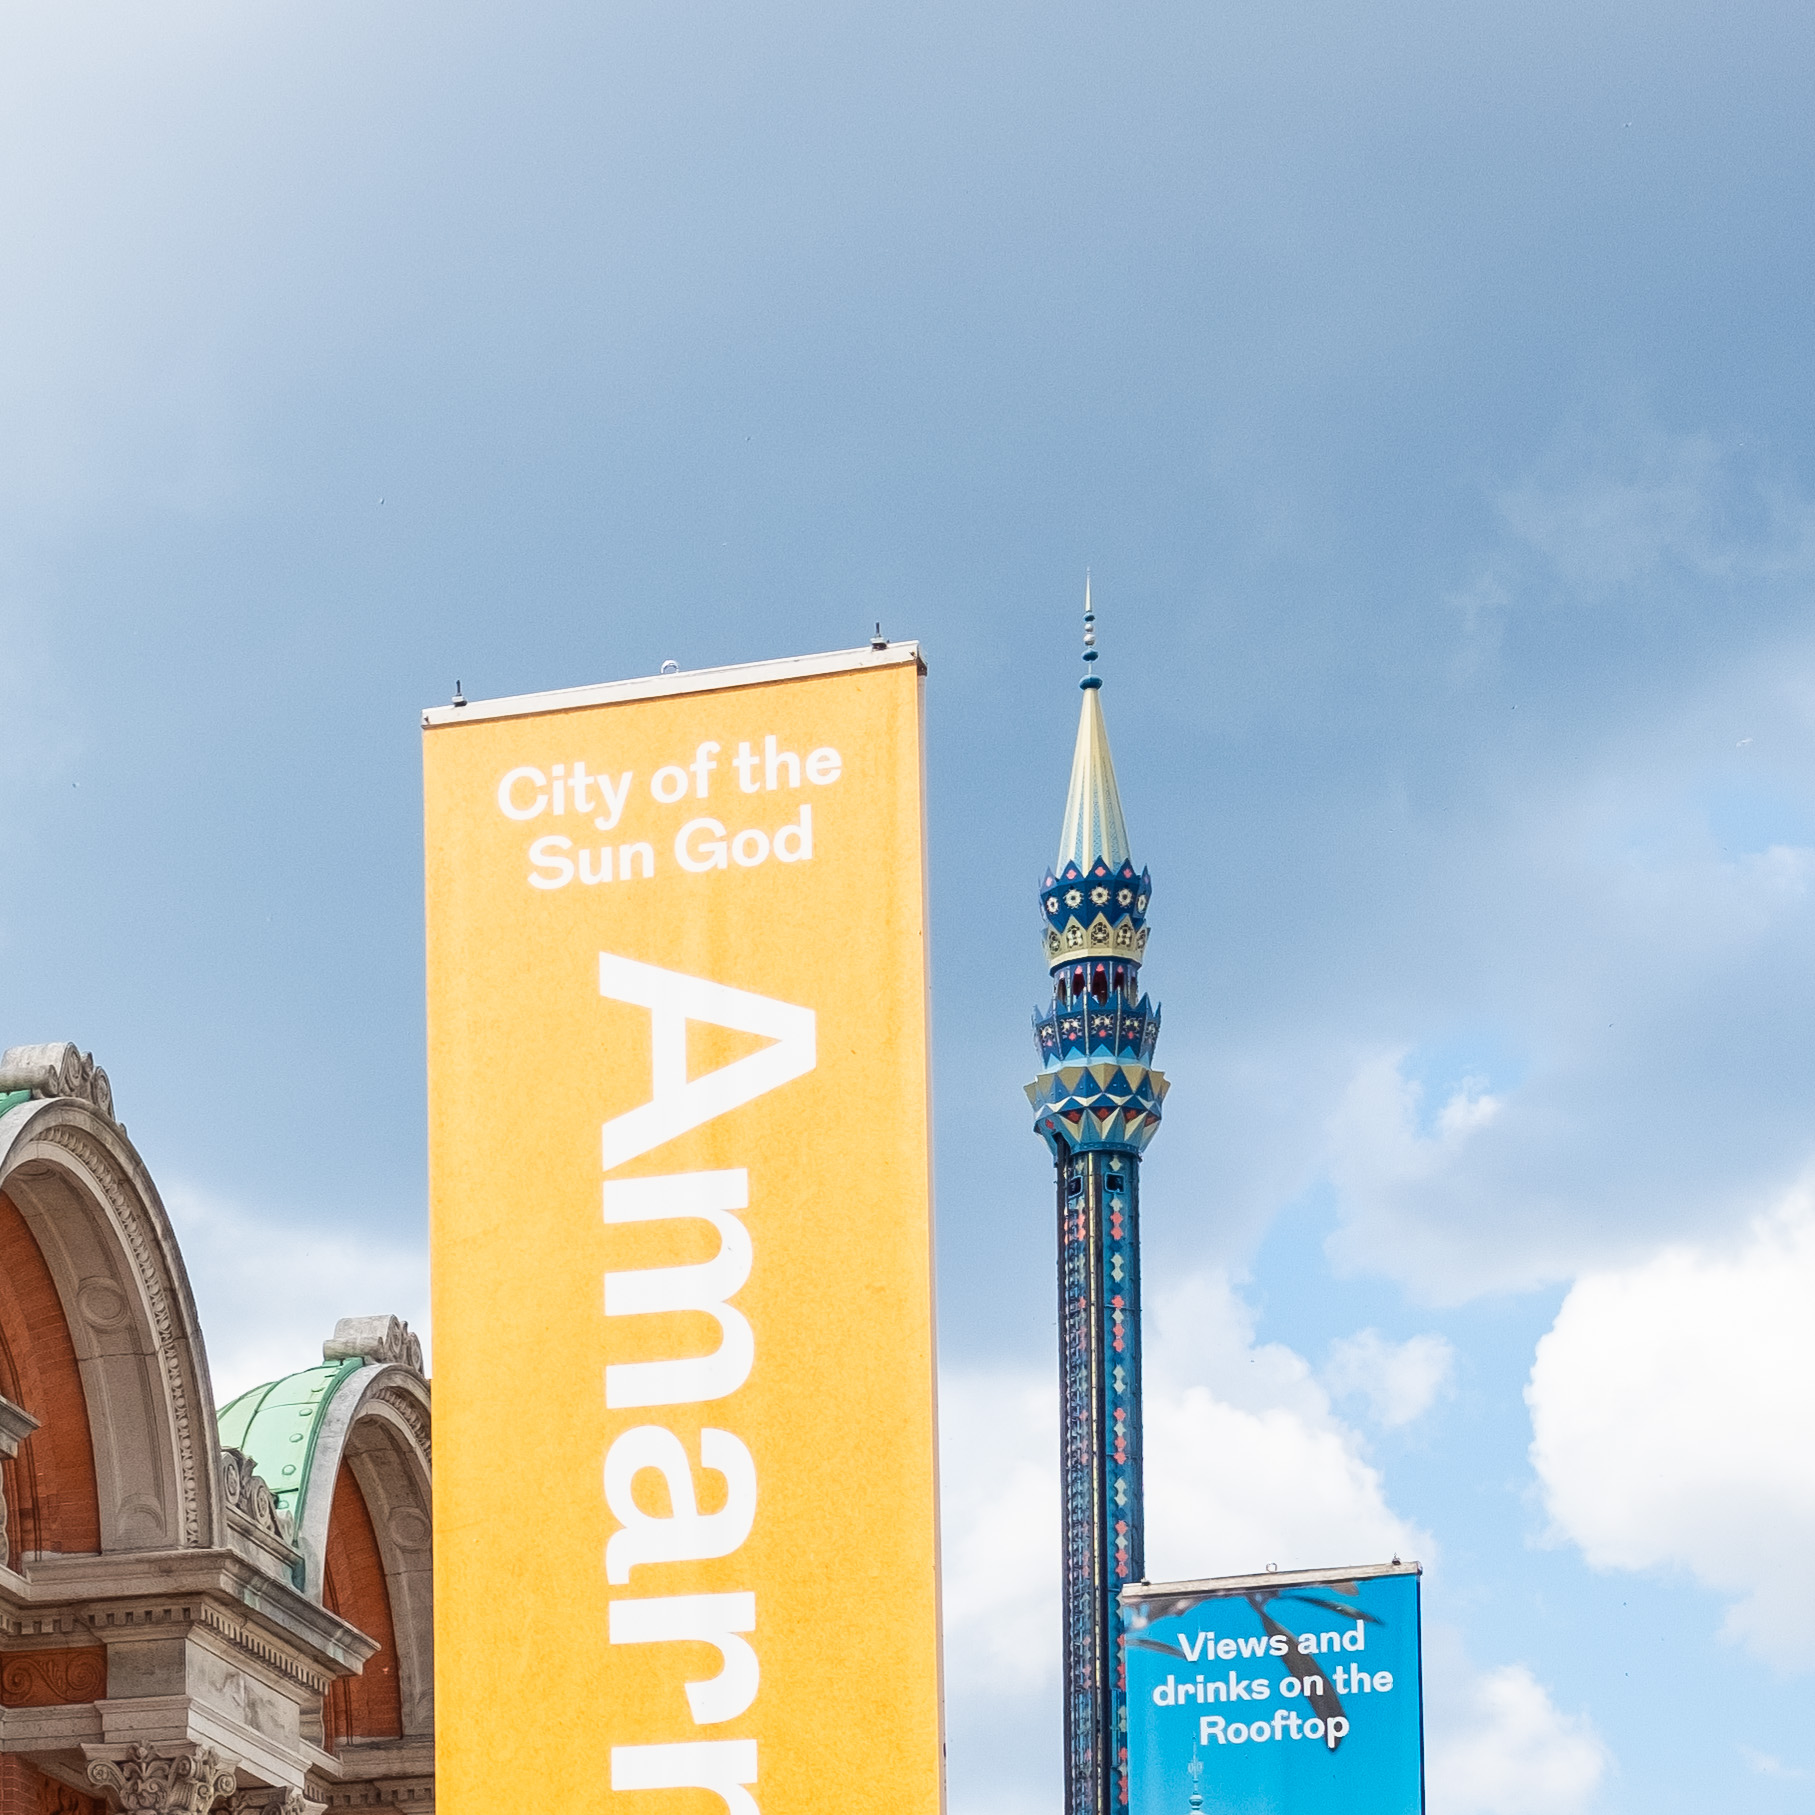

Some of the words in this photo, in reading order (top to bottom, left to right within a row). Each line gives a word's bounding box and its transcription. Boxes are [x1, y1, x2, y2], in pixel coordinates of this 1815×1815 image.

[496, 761, 633, 831] City
[650, 740, 721, 804] of
[732, 734, 843, 794] the
[527, 834, 655, 890] Sun
[673, 803, 814, 873] God
[1177, 1630, 1289, 1662] Views
[1297, 1619, 1365, 1655] and
[1152, 1669, 1271, 1707] drinks
[1279, 1674, 1324, 1698] on
[1332, 1662, 1394, 1695] the
[1199, 1709, 1350, 1749] Rooftop
